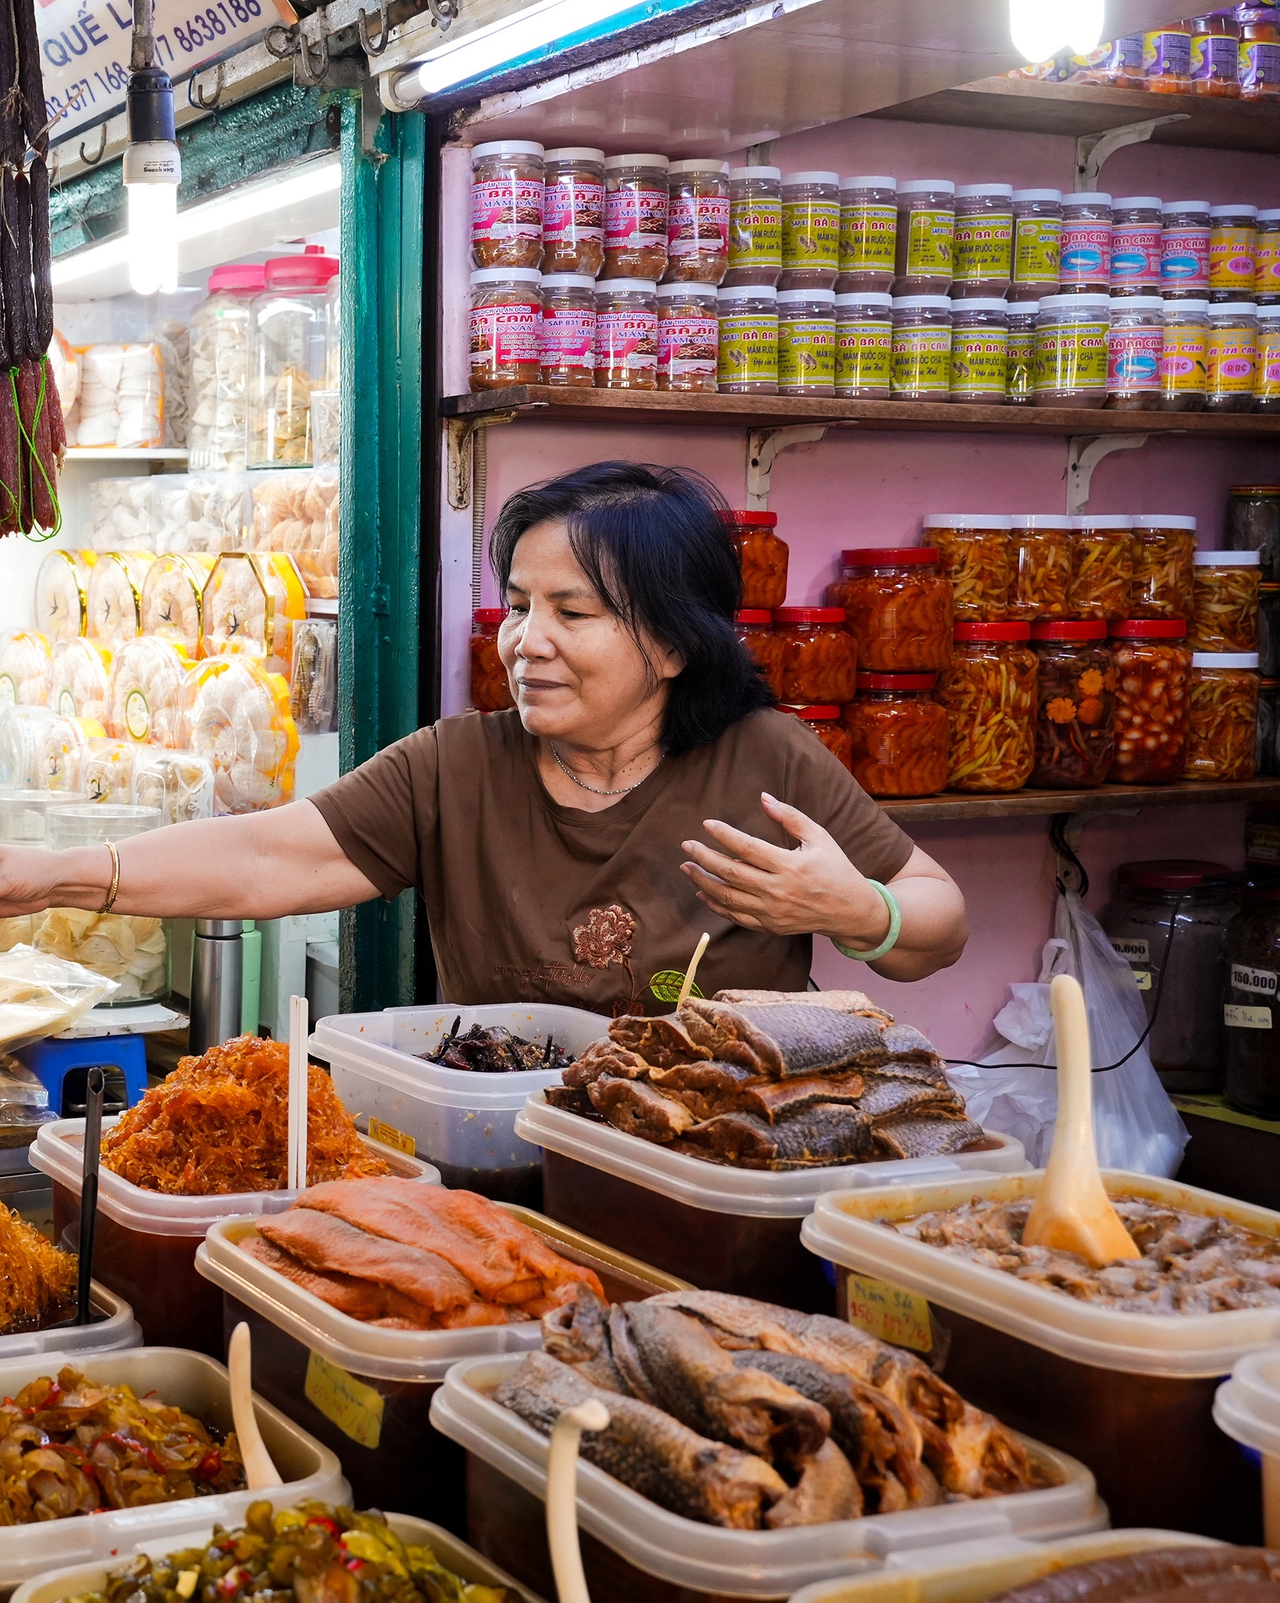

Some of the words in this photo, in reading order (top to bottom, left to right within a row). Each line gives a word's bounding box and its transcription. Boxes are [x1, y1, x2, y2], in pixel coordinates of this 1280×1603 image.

[42, 1, 108, 67] QUẾ
[173, 0, 262, 53] 8638186
[65, 78, 96, 112] 677
[94, 60, 129, 95] 168
[495, 315, 534, 323] CAM
[508, 324, 535, 333] XAY
[1232, 970, 1276, 991] 150.000
